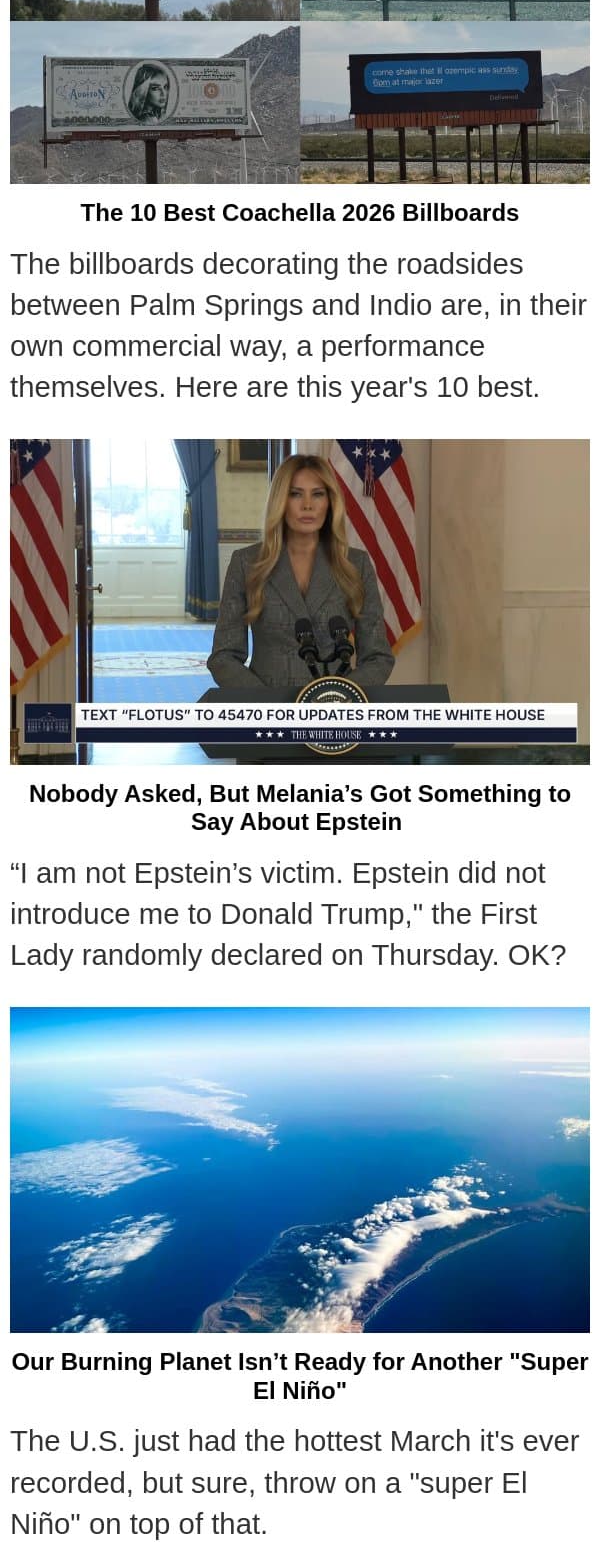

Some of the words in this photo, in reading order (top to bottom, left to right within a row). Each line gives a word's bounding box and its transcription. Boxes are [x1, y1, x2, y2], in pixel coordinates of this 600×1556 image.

[80, 203, 124, 222] The
[132, 204, 156, 222] 10
[164, 204, 216, 222] Best
[223, 203, 336, 222] Coachella
[342, 204, 395, 222] 2026
[404, 203, 519, 222] Billboards
[81, 709, 118, 721] TEXT
[195, 709, 214, 721] TO
[218, 709, 263, 721] 45470
[267, 709, 295, 721] FOR
[299, 709, 364, 721] UPDATES
[368, 709, 409, 721] FROM
[413, 709, 440, 721] THE
[445, 709, 492, 721] WHITE
[496, 709, 545, 721] HOUSE
[292, 730, 306, 739] THE
[308, 730, 334, 739] WHITE
[335, 730, 362, 739] HOUSE
[192, 813, 234, 836] Say
[240, 812, 310, 830] About
[317, 812, 402, 836] Epstein
[254, 1381, 274, 1400] El
[284, 1381, 346, 1400] Niño"
